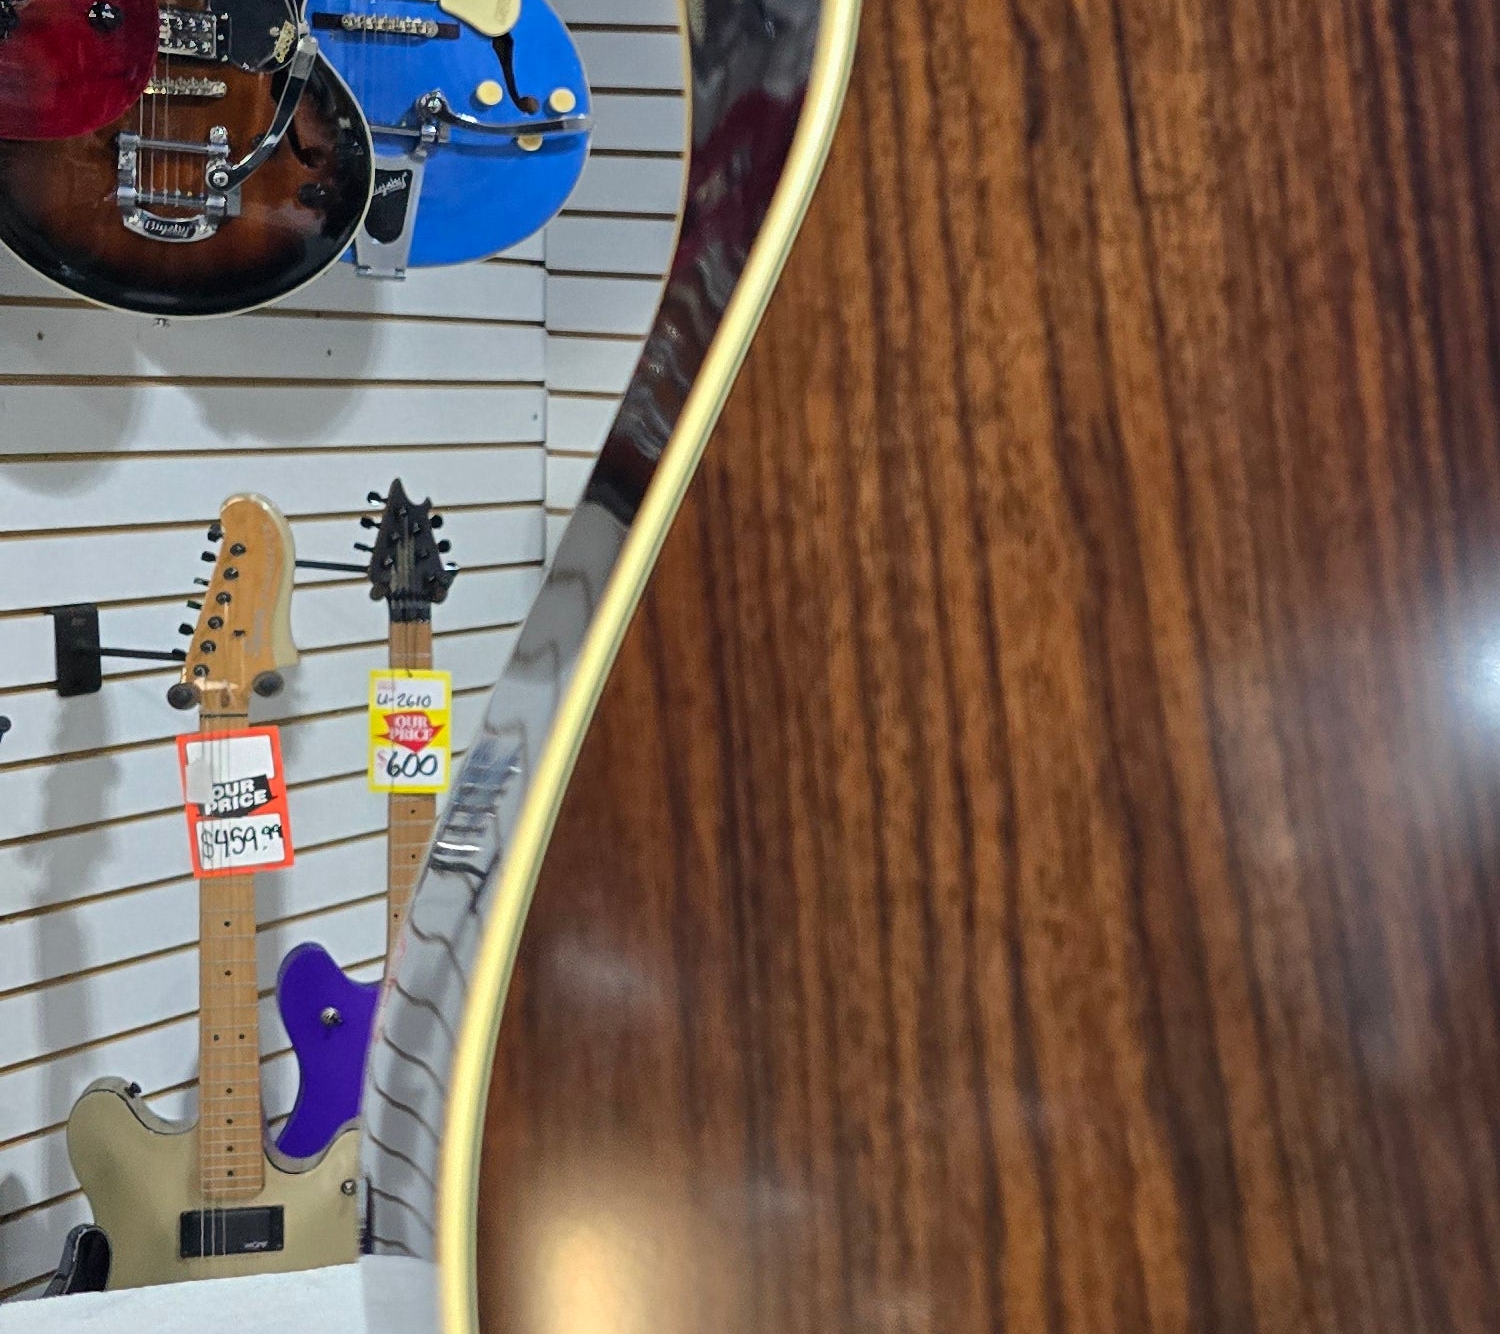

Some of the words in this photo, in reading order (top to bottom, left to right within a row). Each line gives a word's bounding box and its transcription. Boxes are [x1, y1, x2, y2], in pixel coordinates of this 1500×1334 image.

[393, 714, 429, 728] OUR
[212, 778, 255, 800] OUR
[204, 788, 269, 816] PRICE
